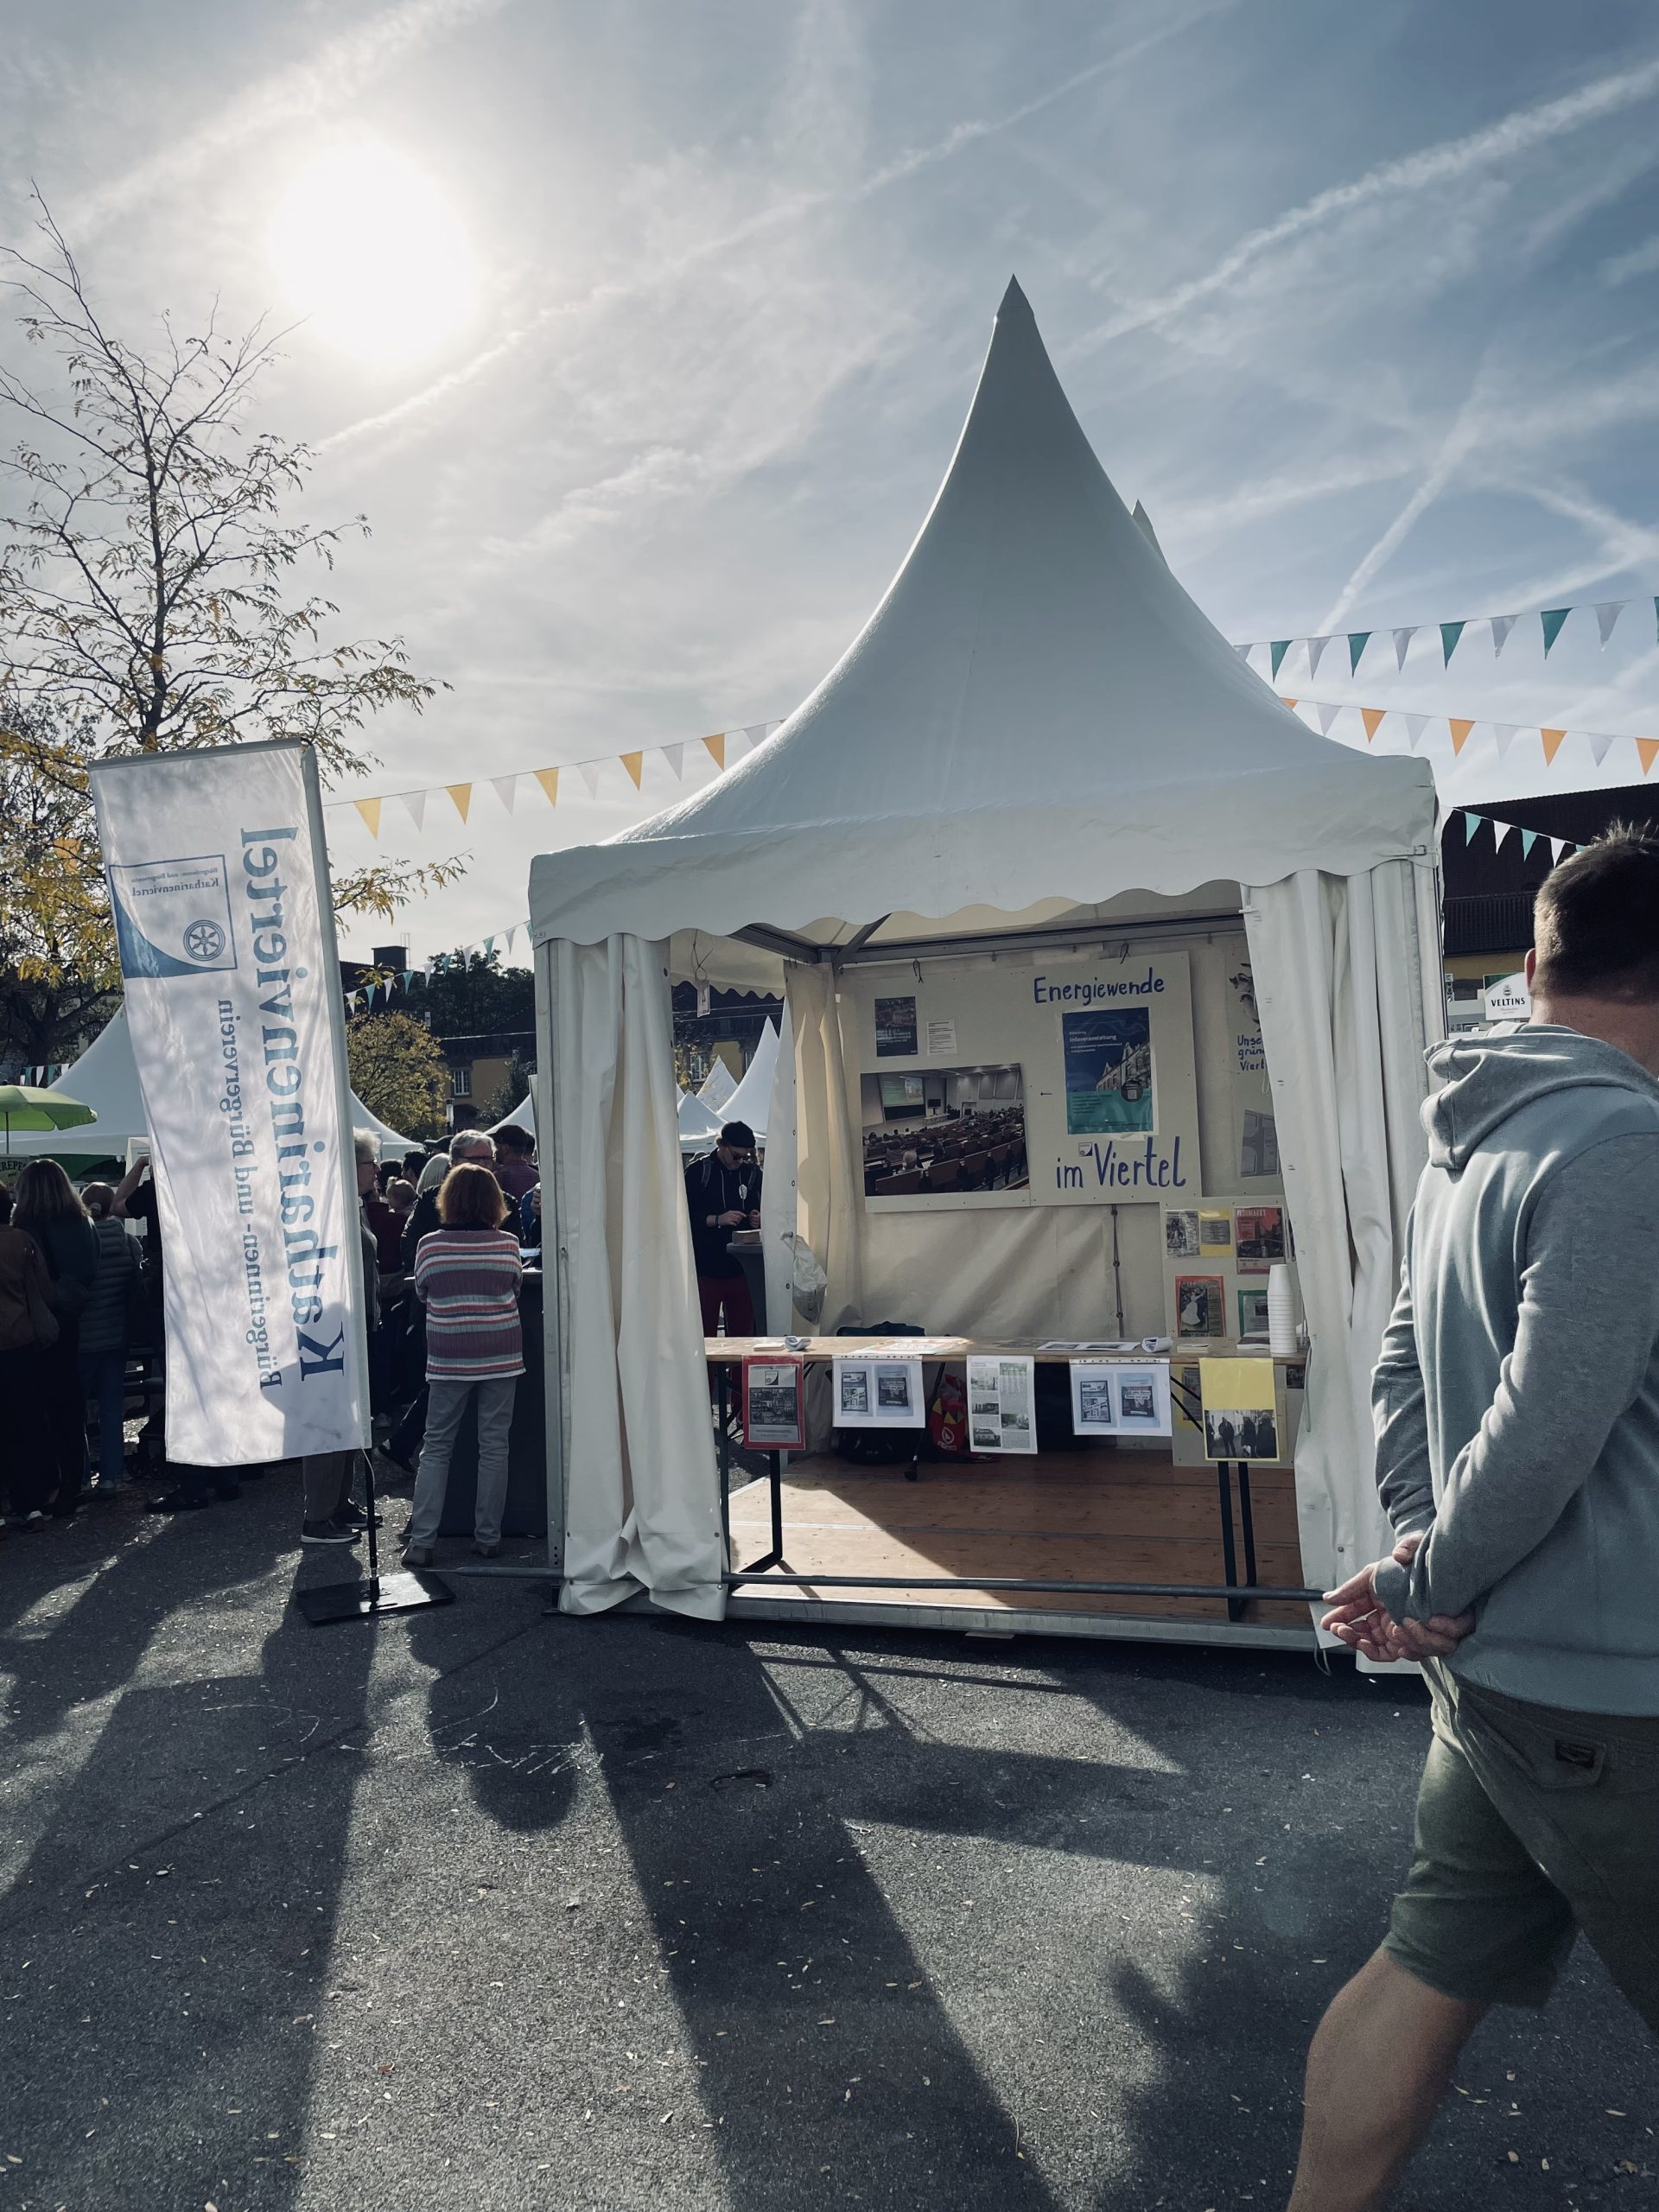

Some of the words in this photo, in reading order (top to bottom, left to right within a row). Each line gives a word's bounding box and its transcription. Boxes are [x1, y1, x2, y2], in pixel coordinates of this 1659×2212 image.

[1033, 967, 1165, 1007] Energiewende
[1491, 997, 1526, 1007] VELTINS
[1238, 1046, 1264, 1060] grün
[0, 1160, 27, 1172] REPE
[1056, 1157, 1084, 1189] im
[1094, 1135, 1186, 1188] Viertel
